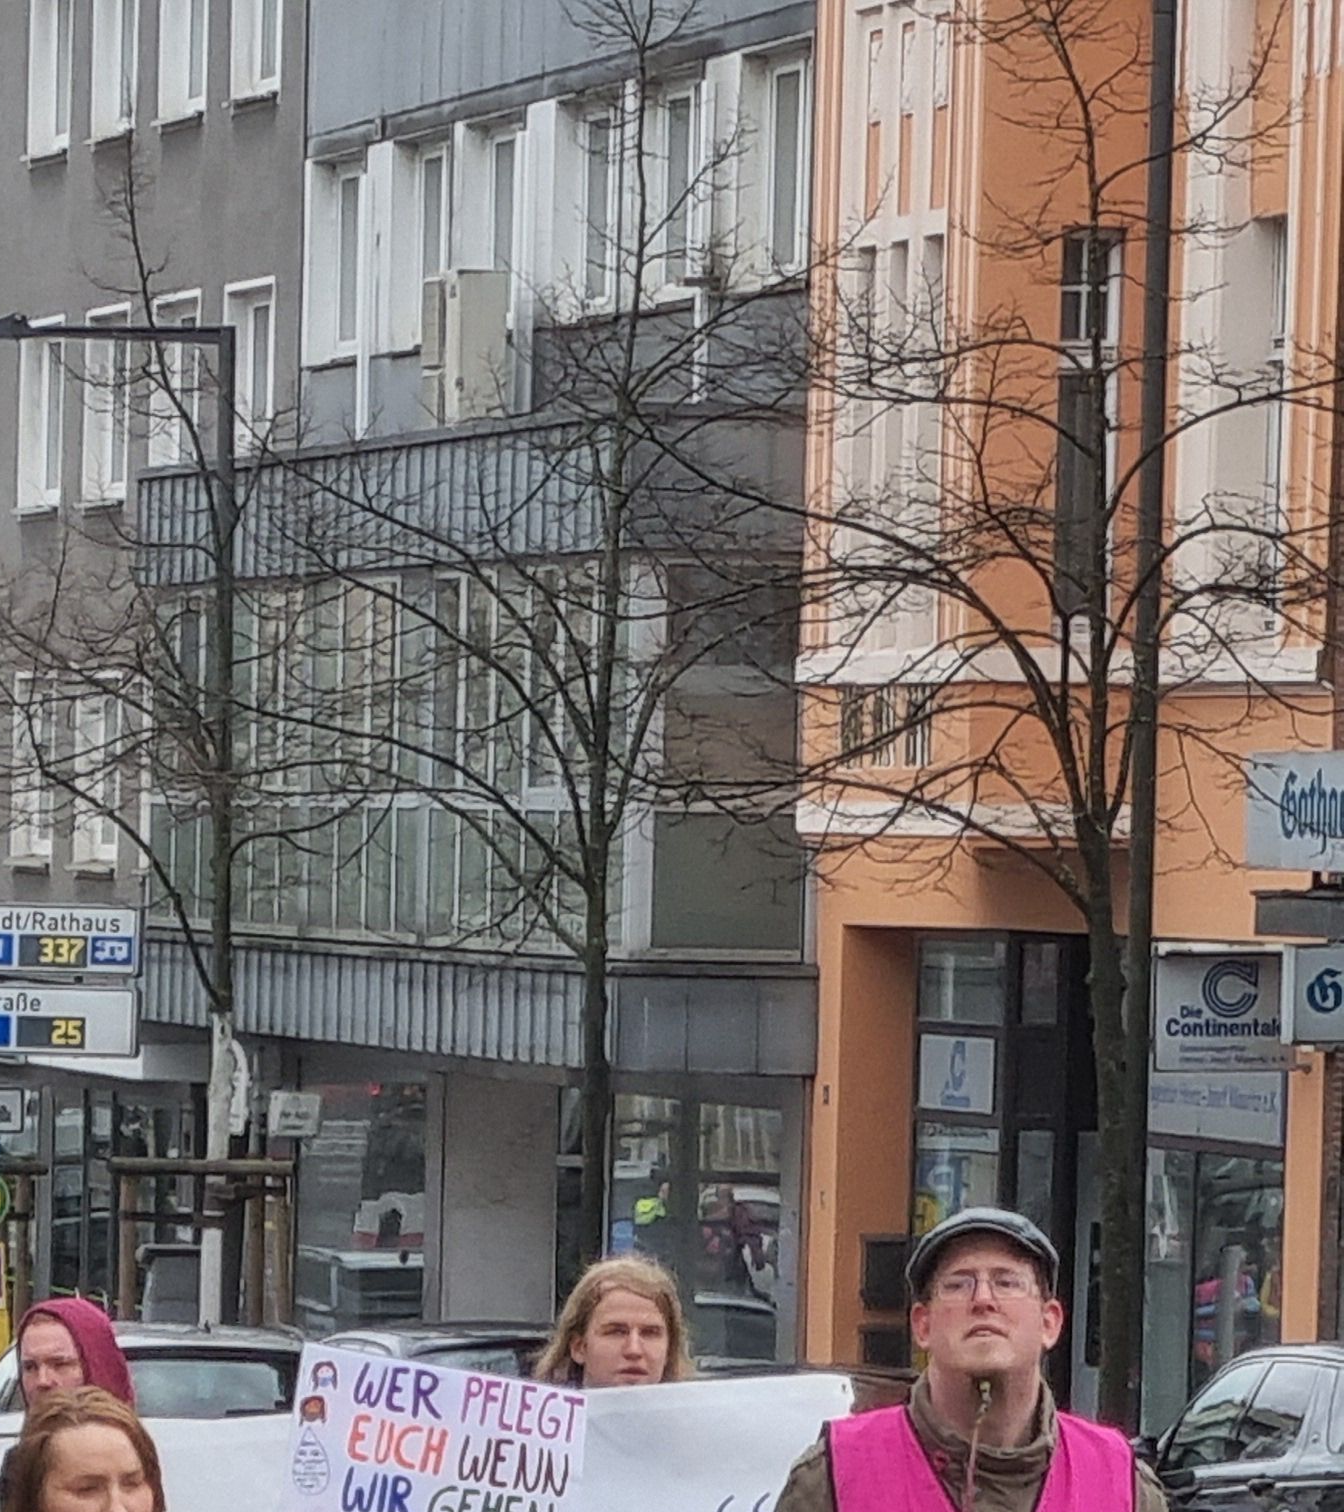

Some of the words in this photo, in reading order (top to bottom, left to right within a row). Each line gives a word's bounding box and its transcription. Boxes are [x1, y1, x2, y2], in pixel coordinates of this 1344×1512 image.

[38, 937, 84, 963] 337
[1180, 1005, 1203, 1021] Die
[51, 1019, 82, 1045] 25
[353, 1361, 443, 1422] WER
[460, 1375, 586, 1444] PFLEGT
[348, 1414, 449, 1476] EUCH
[457, 1438, 572, 1498] WENN
